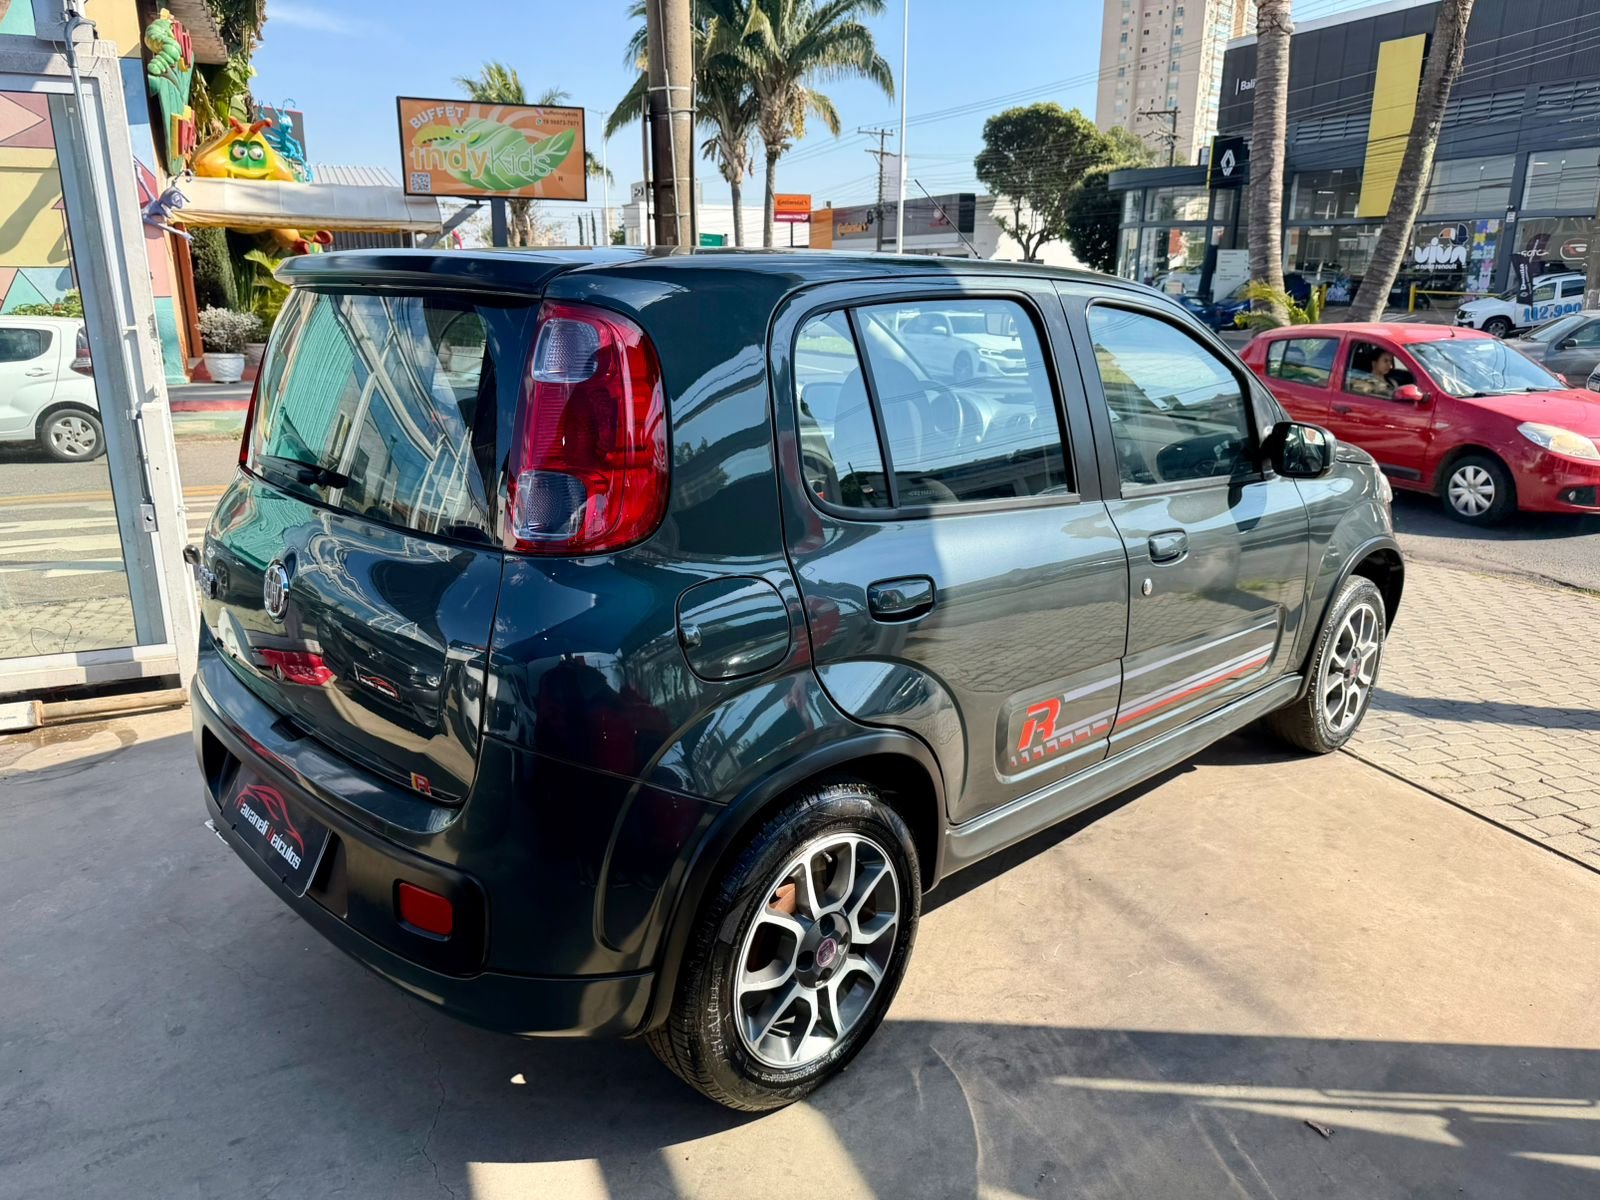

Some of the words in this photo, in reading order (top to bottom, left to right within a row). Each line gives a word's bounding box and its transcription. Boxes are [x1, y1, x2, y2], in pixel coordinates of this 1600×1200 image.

[1241, 79, 1256, 90] Bali
[410, 106, 465, 128] BUFFET
[1017, 697, 1061, 752] R
[411, 772, 432, 796] R
[265, 825, 302, 870] Veículos
